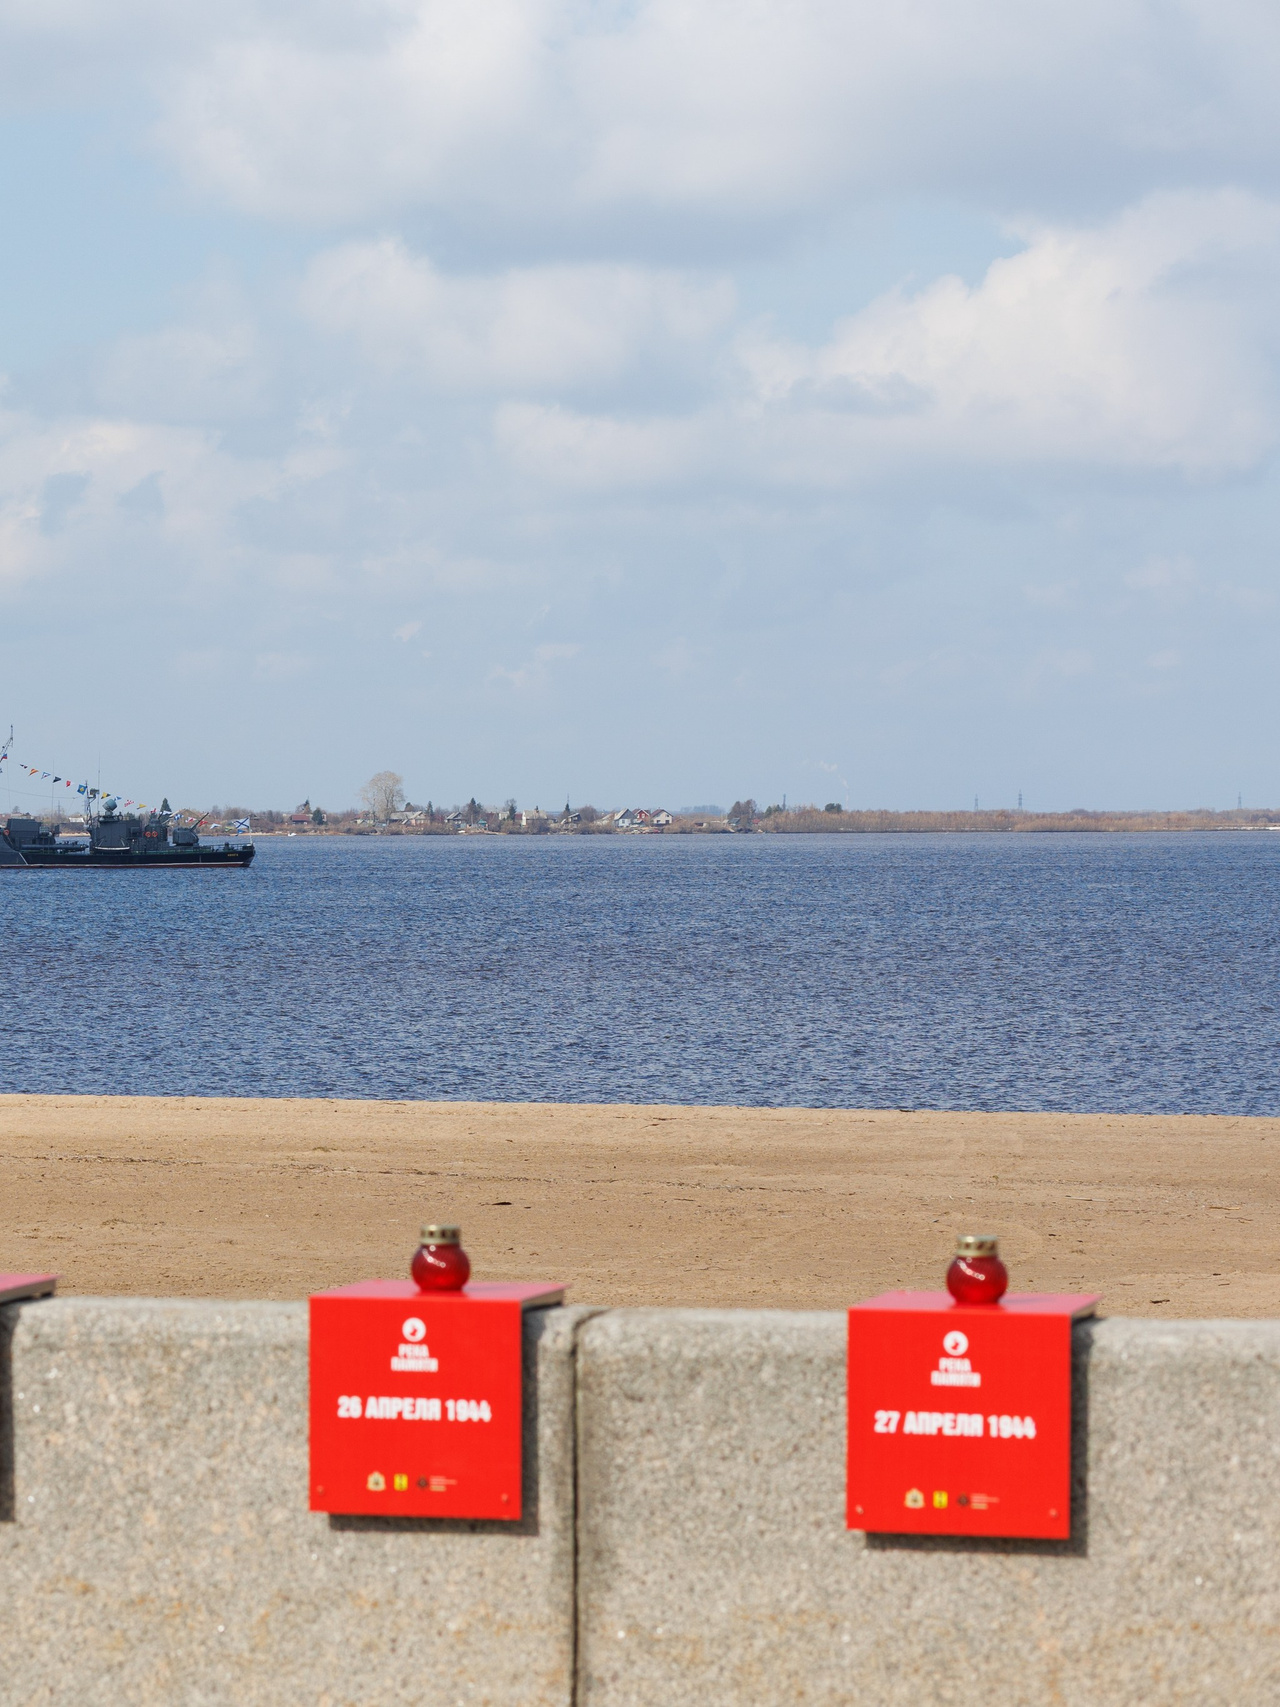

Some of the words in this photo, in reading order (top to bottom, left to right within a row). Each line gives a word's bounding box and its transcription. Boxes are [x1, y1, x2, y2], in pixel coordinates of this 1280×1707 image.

[337, 1395, 362, 1419] 26
[365, 1396, 442, 1421] АПРЕЛЯ
[445, 1399, 492, 1423] 1944
[873, 1410, 900, 1434] 27
[903, 1411, 984, 1438] АПРЕЛЯ
[987, 1415, 1037, 1440] 1944
